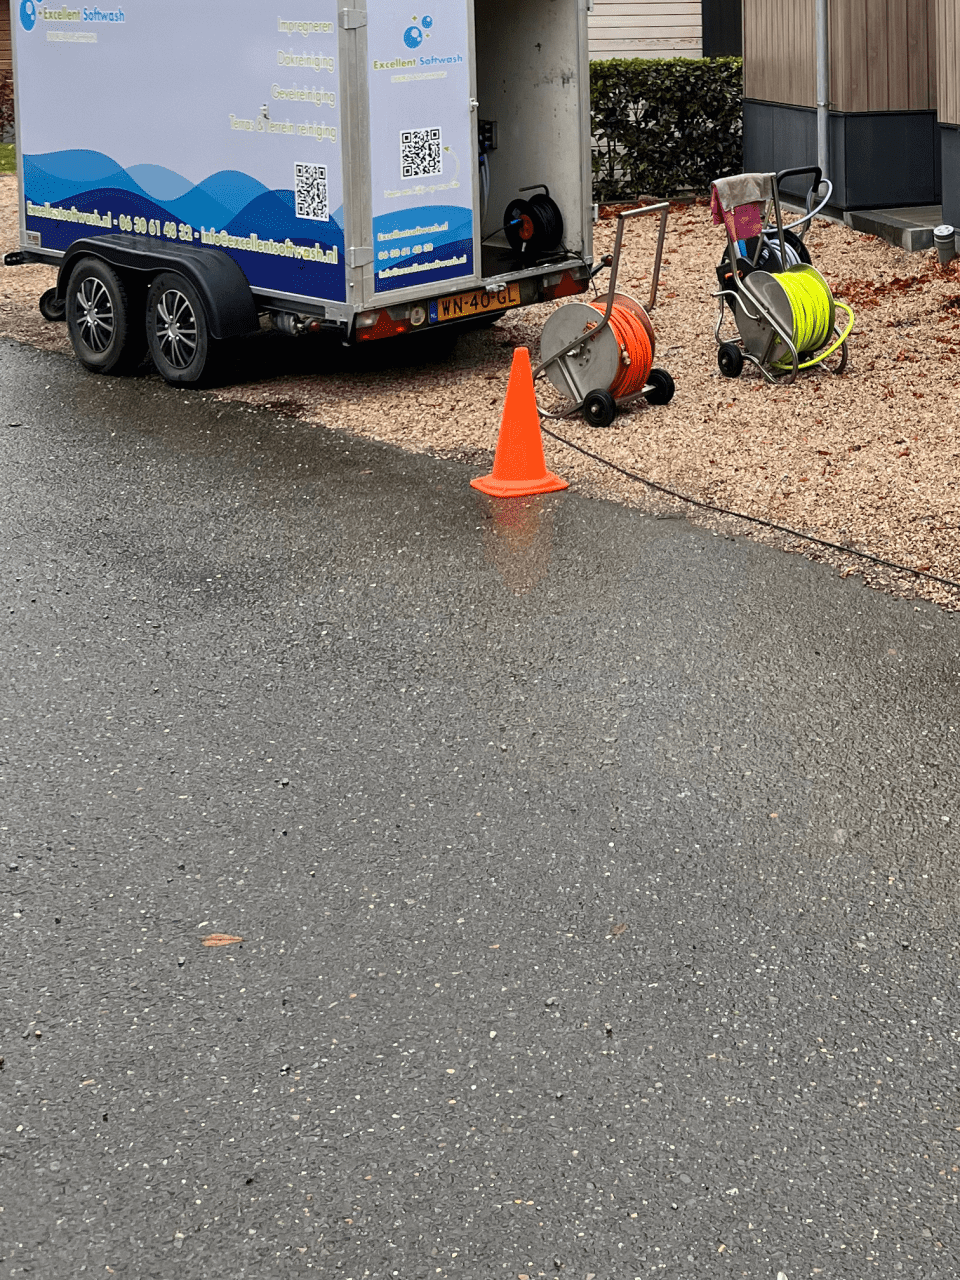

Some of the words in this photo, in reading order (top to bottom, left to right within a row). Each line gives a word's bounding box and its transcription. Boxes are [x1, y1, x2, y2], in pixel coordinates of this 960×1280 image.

[43, 5, 81, 21] Excellent
[82, 5, 125, 23] Softwash
[277, 16, 334, 37] Impregneren
[277, 48, 334, 73] Dakreiniging
[373, 57, 417, 70] Excellent
[419, 53, 463, 66] Softwash
[271, 82, 336, 108] Gevelreiniging
[229, 113, 255, 131] Terras
[255, 115, 264, 132] &
[296, 120, 337, 143] reiniging
[118, 214, 133, 232] 06
[133, 216, 147, 234] 30
[148, 218, 161, 236] 61
[163, 221, 177, 239] 48
[178, 223, 193, 241] 32
[200, 226, 339, 265] info@excellentsoftwash.nl
[441, 287, 516, 316] WN-40-GL
